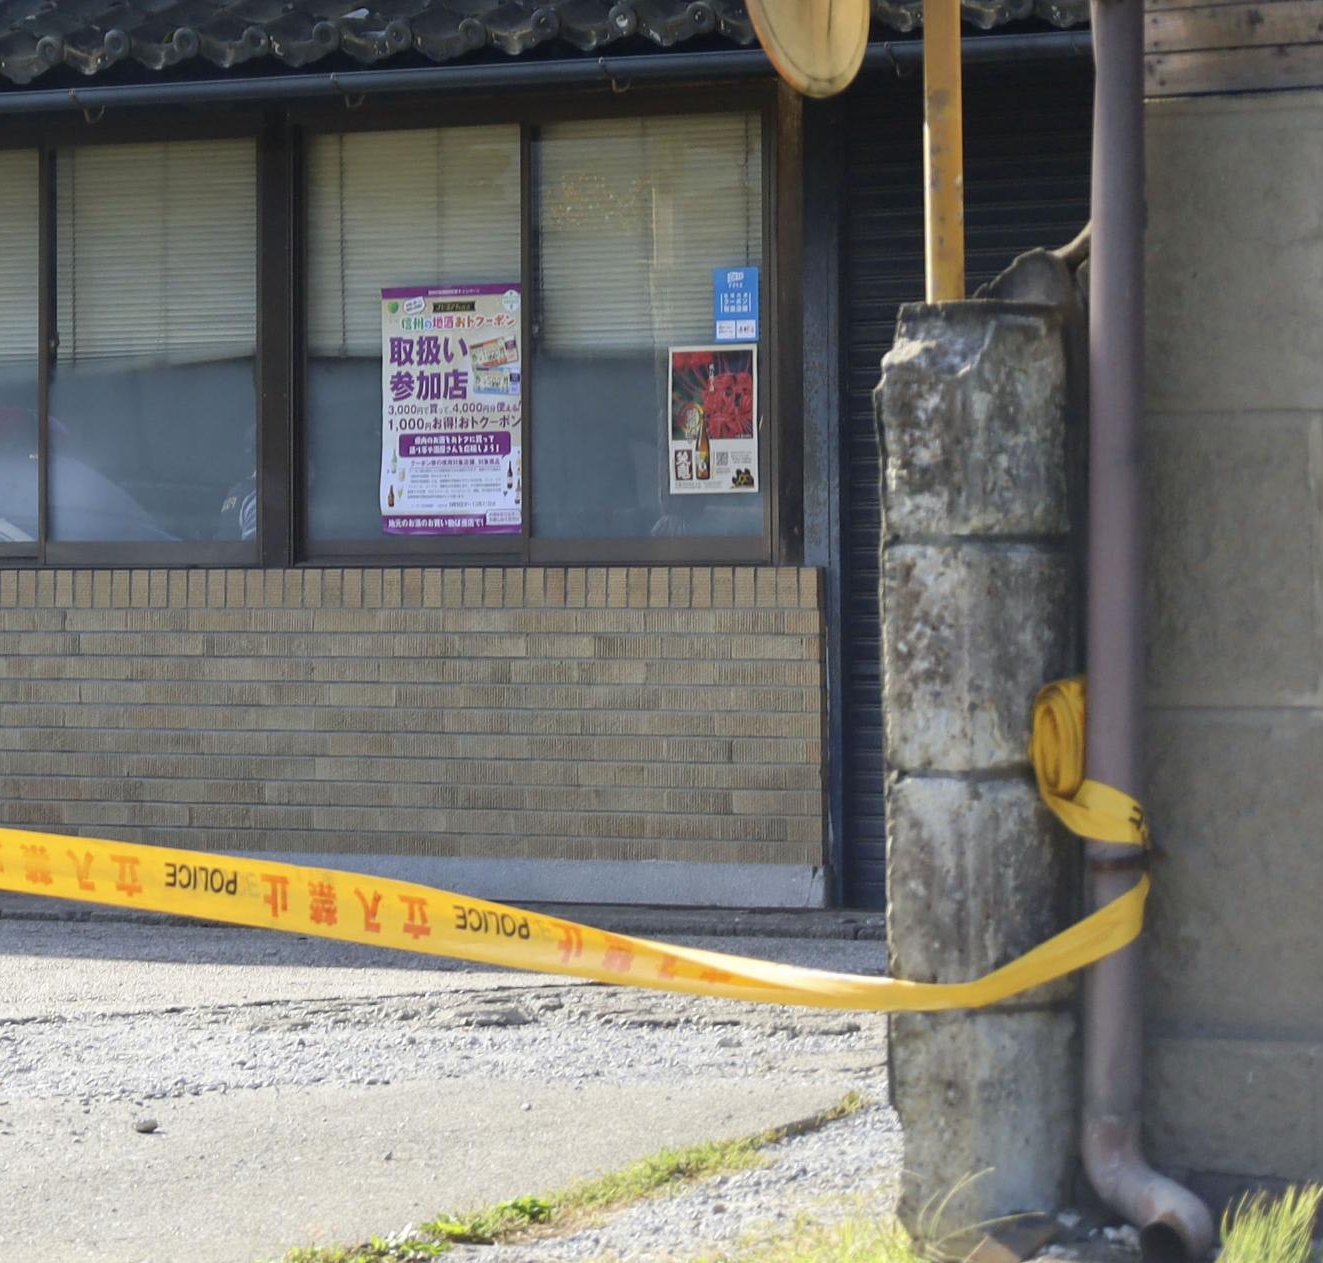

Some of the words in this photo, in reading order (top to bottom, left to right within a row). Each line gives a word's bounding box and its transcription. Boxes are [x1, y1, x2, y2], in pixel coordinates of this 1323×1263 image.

[389, 336, 468, 367] 取扱い
[389, 369, 469, 402] 参加店
[164, 863, 238, 895] POLICE
[260, 873, 431, 941] 立入禁止
[455, 905, 531, 941] POLICE
